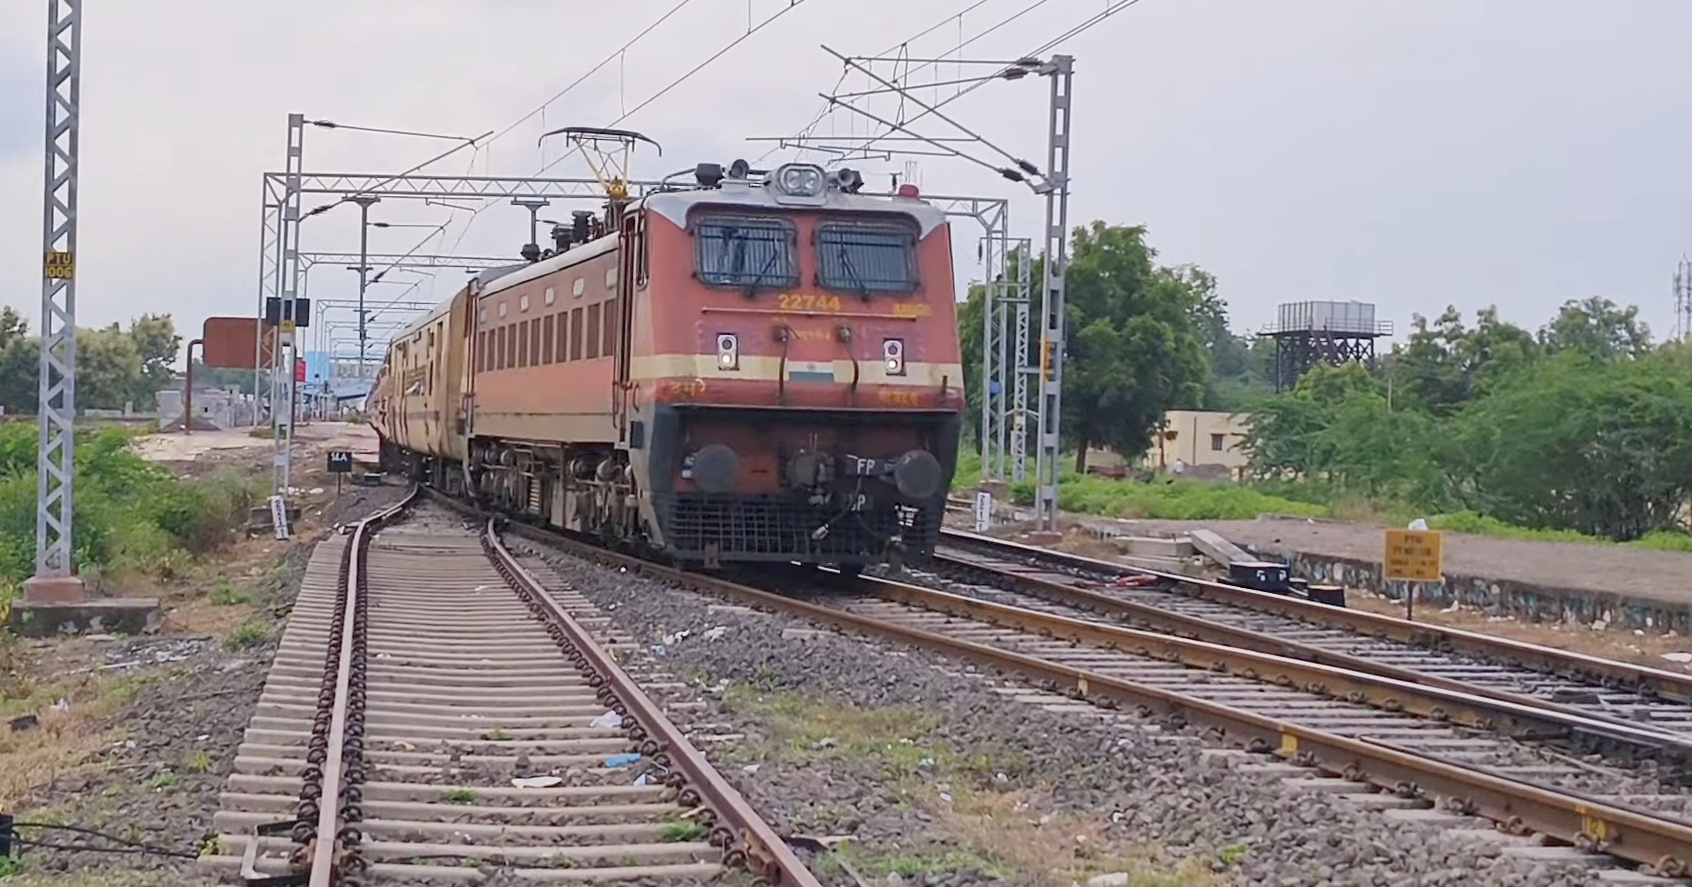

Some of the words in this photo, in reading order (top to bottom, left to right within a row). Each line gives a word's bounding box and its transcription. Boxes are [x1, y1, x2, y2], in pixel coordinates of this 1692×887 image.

[46, 253, 71, 264] PTU
[45, 266, 72, 278] 1006
[778, 294, 841, 310] 22744
[857, 458, 876, 475] FP
